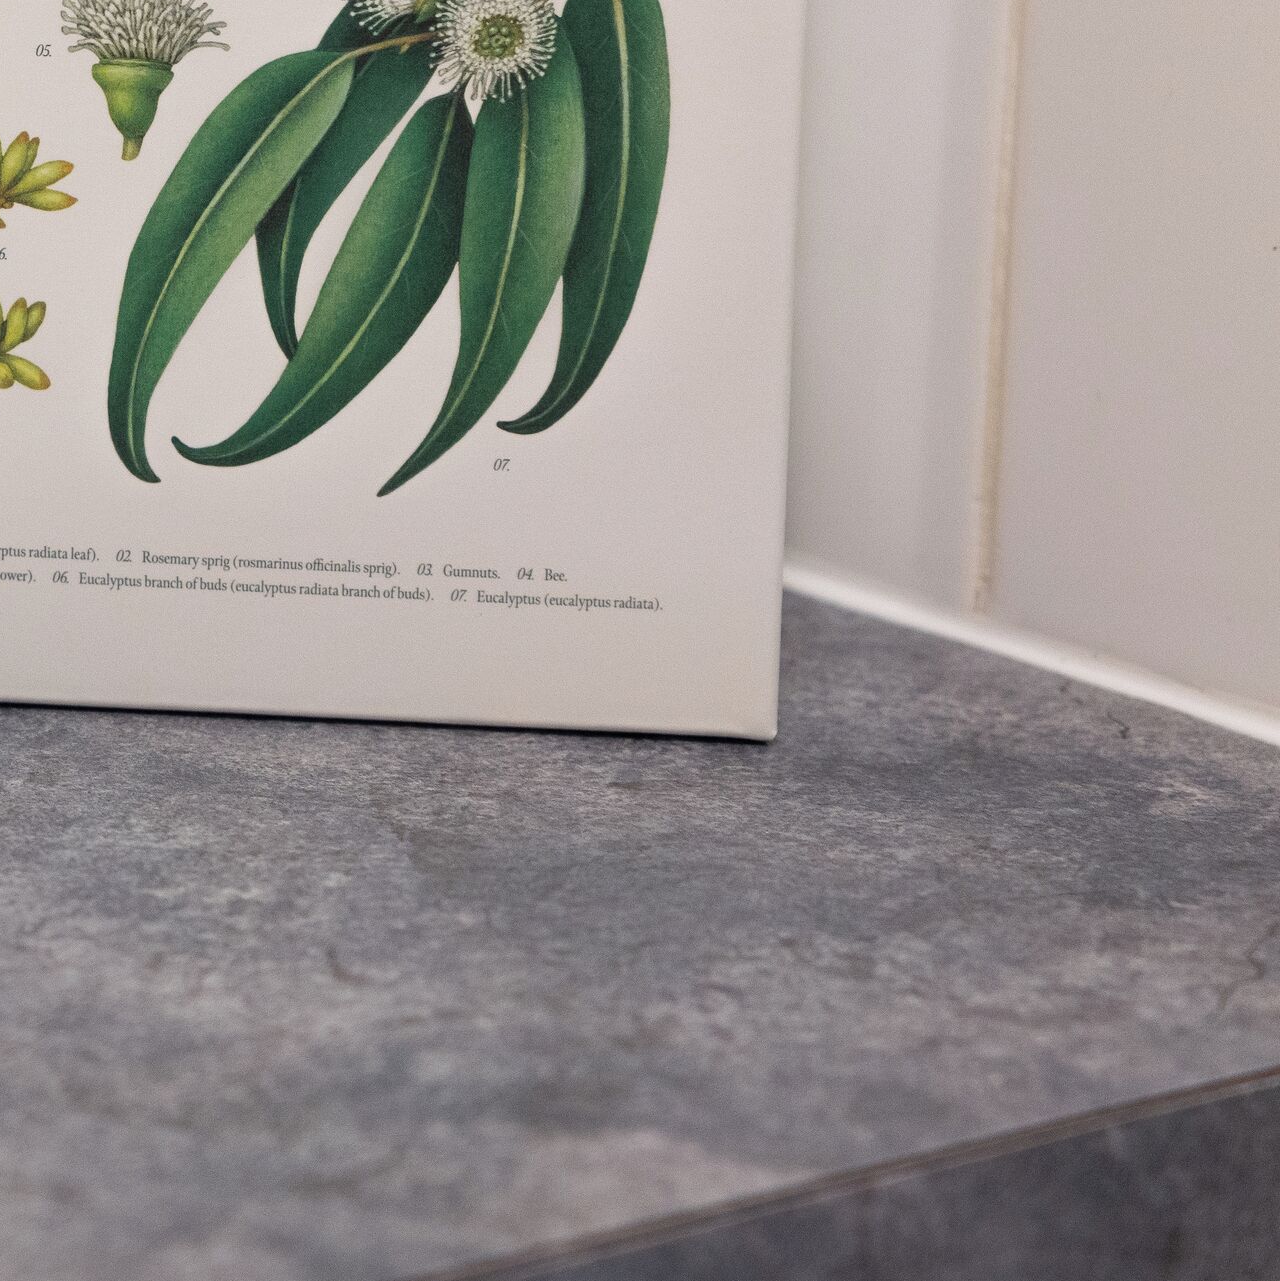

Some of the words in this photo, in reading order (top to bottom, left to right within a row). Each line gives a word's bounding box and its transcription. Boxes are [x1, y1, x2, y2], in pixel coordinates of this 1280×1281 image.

[35, 44, 52, 57] 05.
[493, 458, 511, 472] 07.
[28, 545, 69, 560] radiata
[70, 547, 100, 563] leaf).
[115, 549, 132, 563] 02.
[141, 550, 200, 570] Rosemary
[201, 554, 231, 572] sprig
[232, 555, 304, 571] (rosmarinus
[305, 558, 362, 574] officinalis
[363, 561, 401, 579] sprig).
[416, 562, 433, 577] 03.
[442, 563, 501, 580] Gumnuts.
[516, 567, 534, 581] 04.
[543, 568, 568, 582] Bee.
[52, 570, 70, 584] 06.
[78, 571, 142, 591] Eucalyptus
[144, 574, 184, 589] branch
[185, 576, 199, 590] of
[199, 577, 228, 592] buds
[230, 579, 297, 598] (eucalyptus
[298, 582, 340, 597] radiata
[341, 583, 381, 599] branch
[382, 586, 397, 599] of
[397, 586, 435, 602] buds).
[450, 588, 469, 602] 07.
[476, 590, 542, 609] Eucalyptus
[543, 593, 612, 612] (eucalyptus
[613, 596, 664, 612] radiata).
